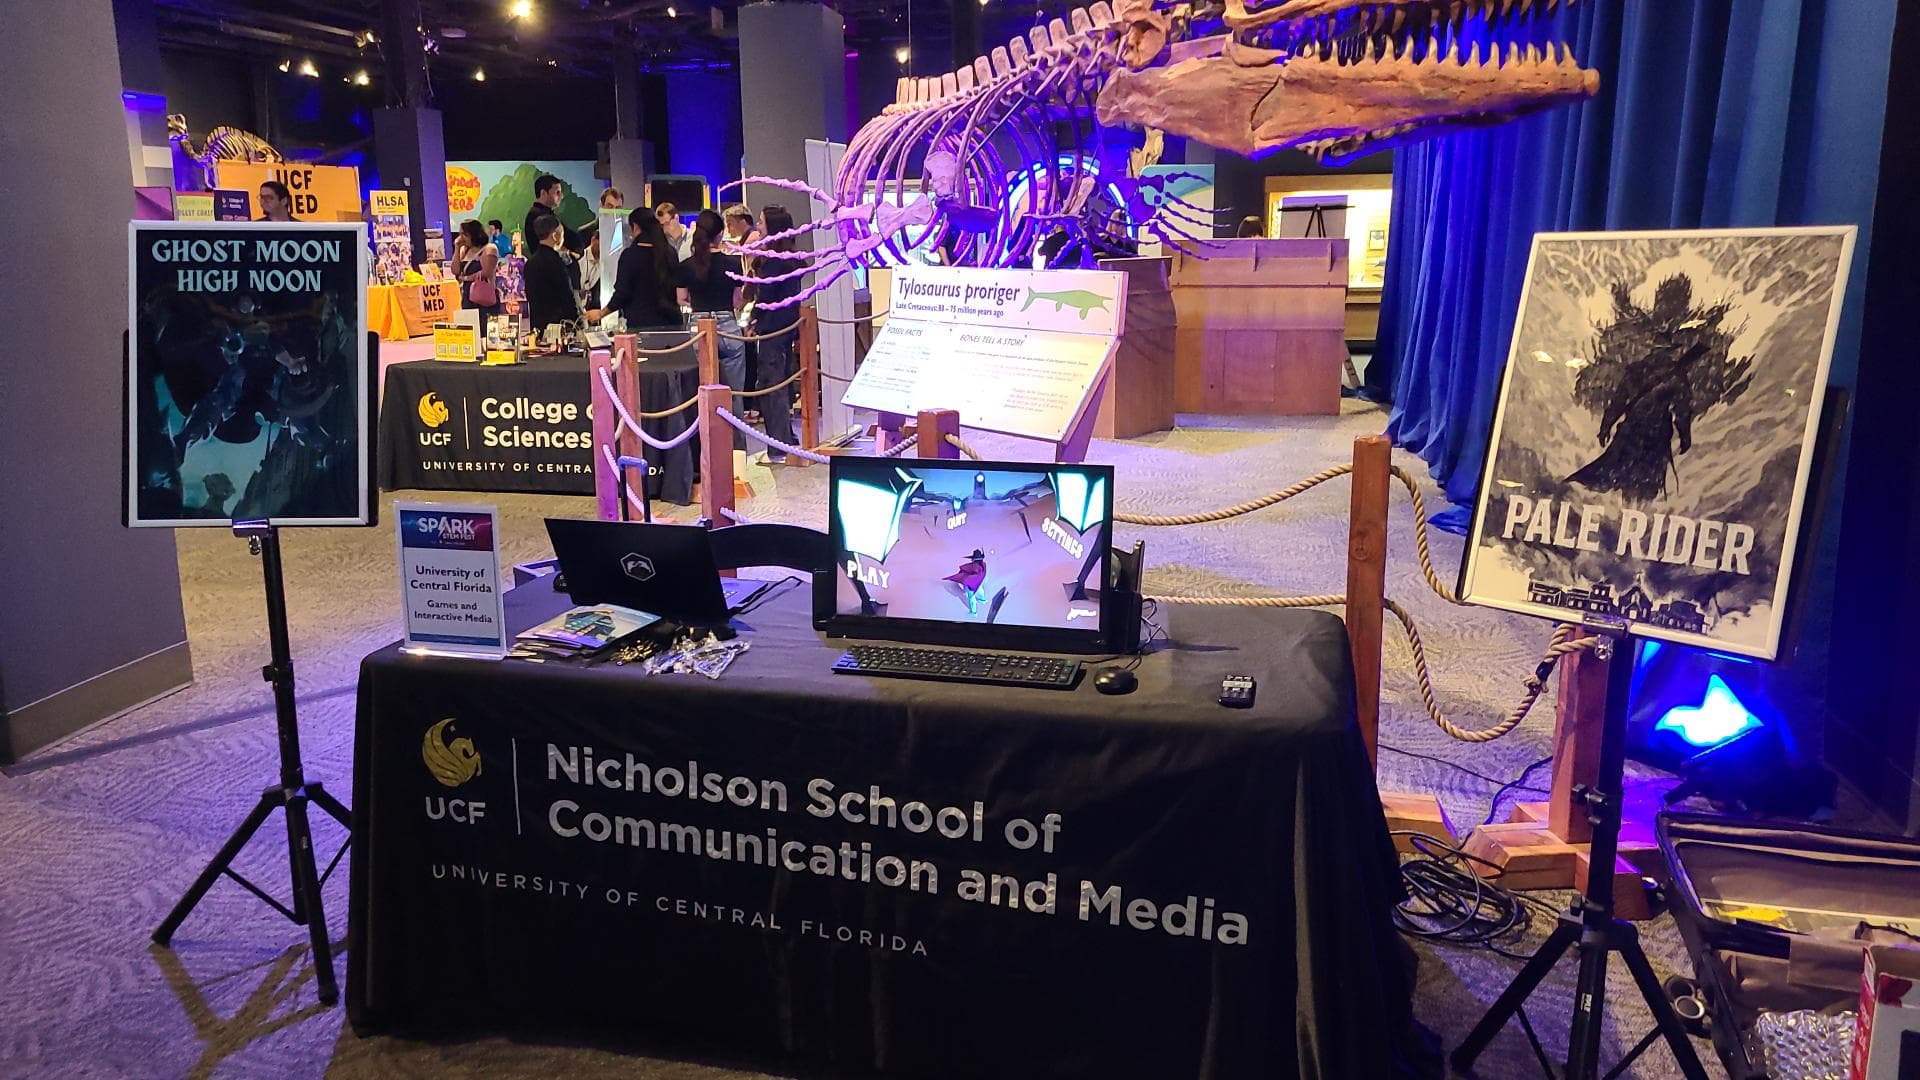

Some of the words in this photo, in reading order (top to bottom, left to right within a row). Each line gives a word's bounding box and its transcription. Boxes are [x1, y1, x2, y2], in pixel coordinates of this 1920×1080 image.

[275, 169, 313, 190] UCF
[289, 194, 318, 215] ED
[376, 195, 405, 207] HLSA
[151, 239, 246, 263] GHOST
[255, 239, 341, 263] MOON
[177, 269, 238, 293] HIGH
[249, 269, 322, 293] NOON
[422, 284, 441, 298] UCF
[898, 277, 961, 300] Tylosaurus
[964, 282, 1020, 306] proriger
[423, 299, 445, 313] MED
[895, 301, 907, 309] Late
[957, 306, 976, 315] million
[977, 309, 992, 317] years
[993, 310, 1004, 318] ago
[481, 397, 578, 424] College
[420, 432, 452, 446] UCF
[483, 425, 593, 450] Sciences
[423, 461, 505, 472] UNIVERSITY
[513, 463, 530, 472] OF
[537, 463, 592, 474] CENTRA
[418, 516, 475, 537] SPARK
[947, 512, 967, 530] QUIT
[1041, 517, 1084, 559] SETTINGS
[1502, 494, 1604, 551] PALE
[1615, 508, 1755, 575] RIDER
[415, 565, 471, 580] University
[473, 569, 485, 578] of
[847, 559, 890, 589] PLAY
[410, 579, 450, 592] Central
[454, 582, 492, 593] Florida
[427, 600, 459, 610] Games
[460, 602, 477, 611] and
[414, 611, 463, 622] Interactive
[465, 614, 492, 624] Media
[547, 743, 787, 813] Nicholson
[806, 778, 984, 842] School
[1004, 812, 1062, 854] of
[425, 796, 487, 825] UCF
[548, 799, 939, 895] Communication
[957, 869, 1058, 915] and
[1078, 879, 1249, 946] Media
[432, 863, 589, 900] UNIVERSITY
[606, 888, 639, 907] OF
[656, 896, 781, 931] CENTRAL
[801, 920, 928, 957] FLORIDA
